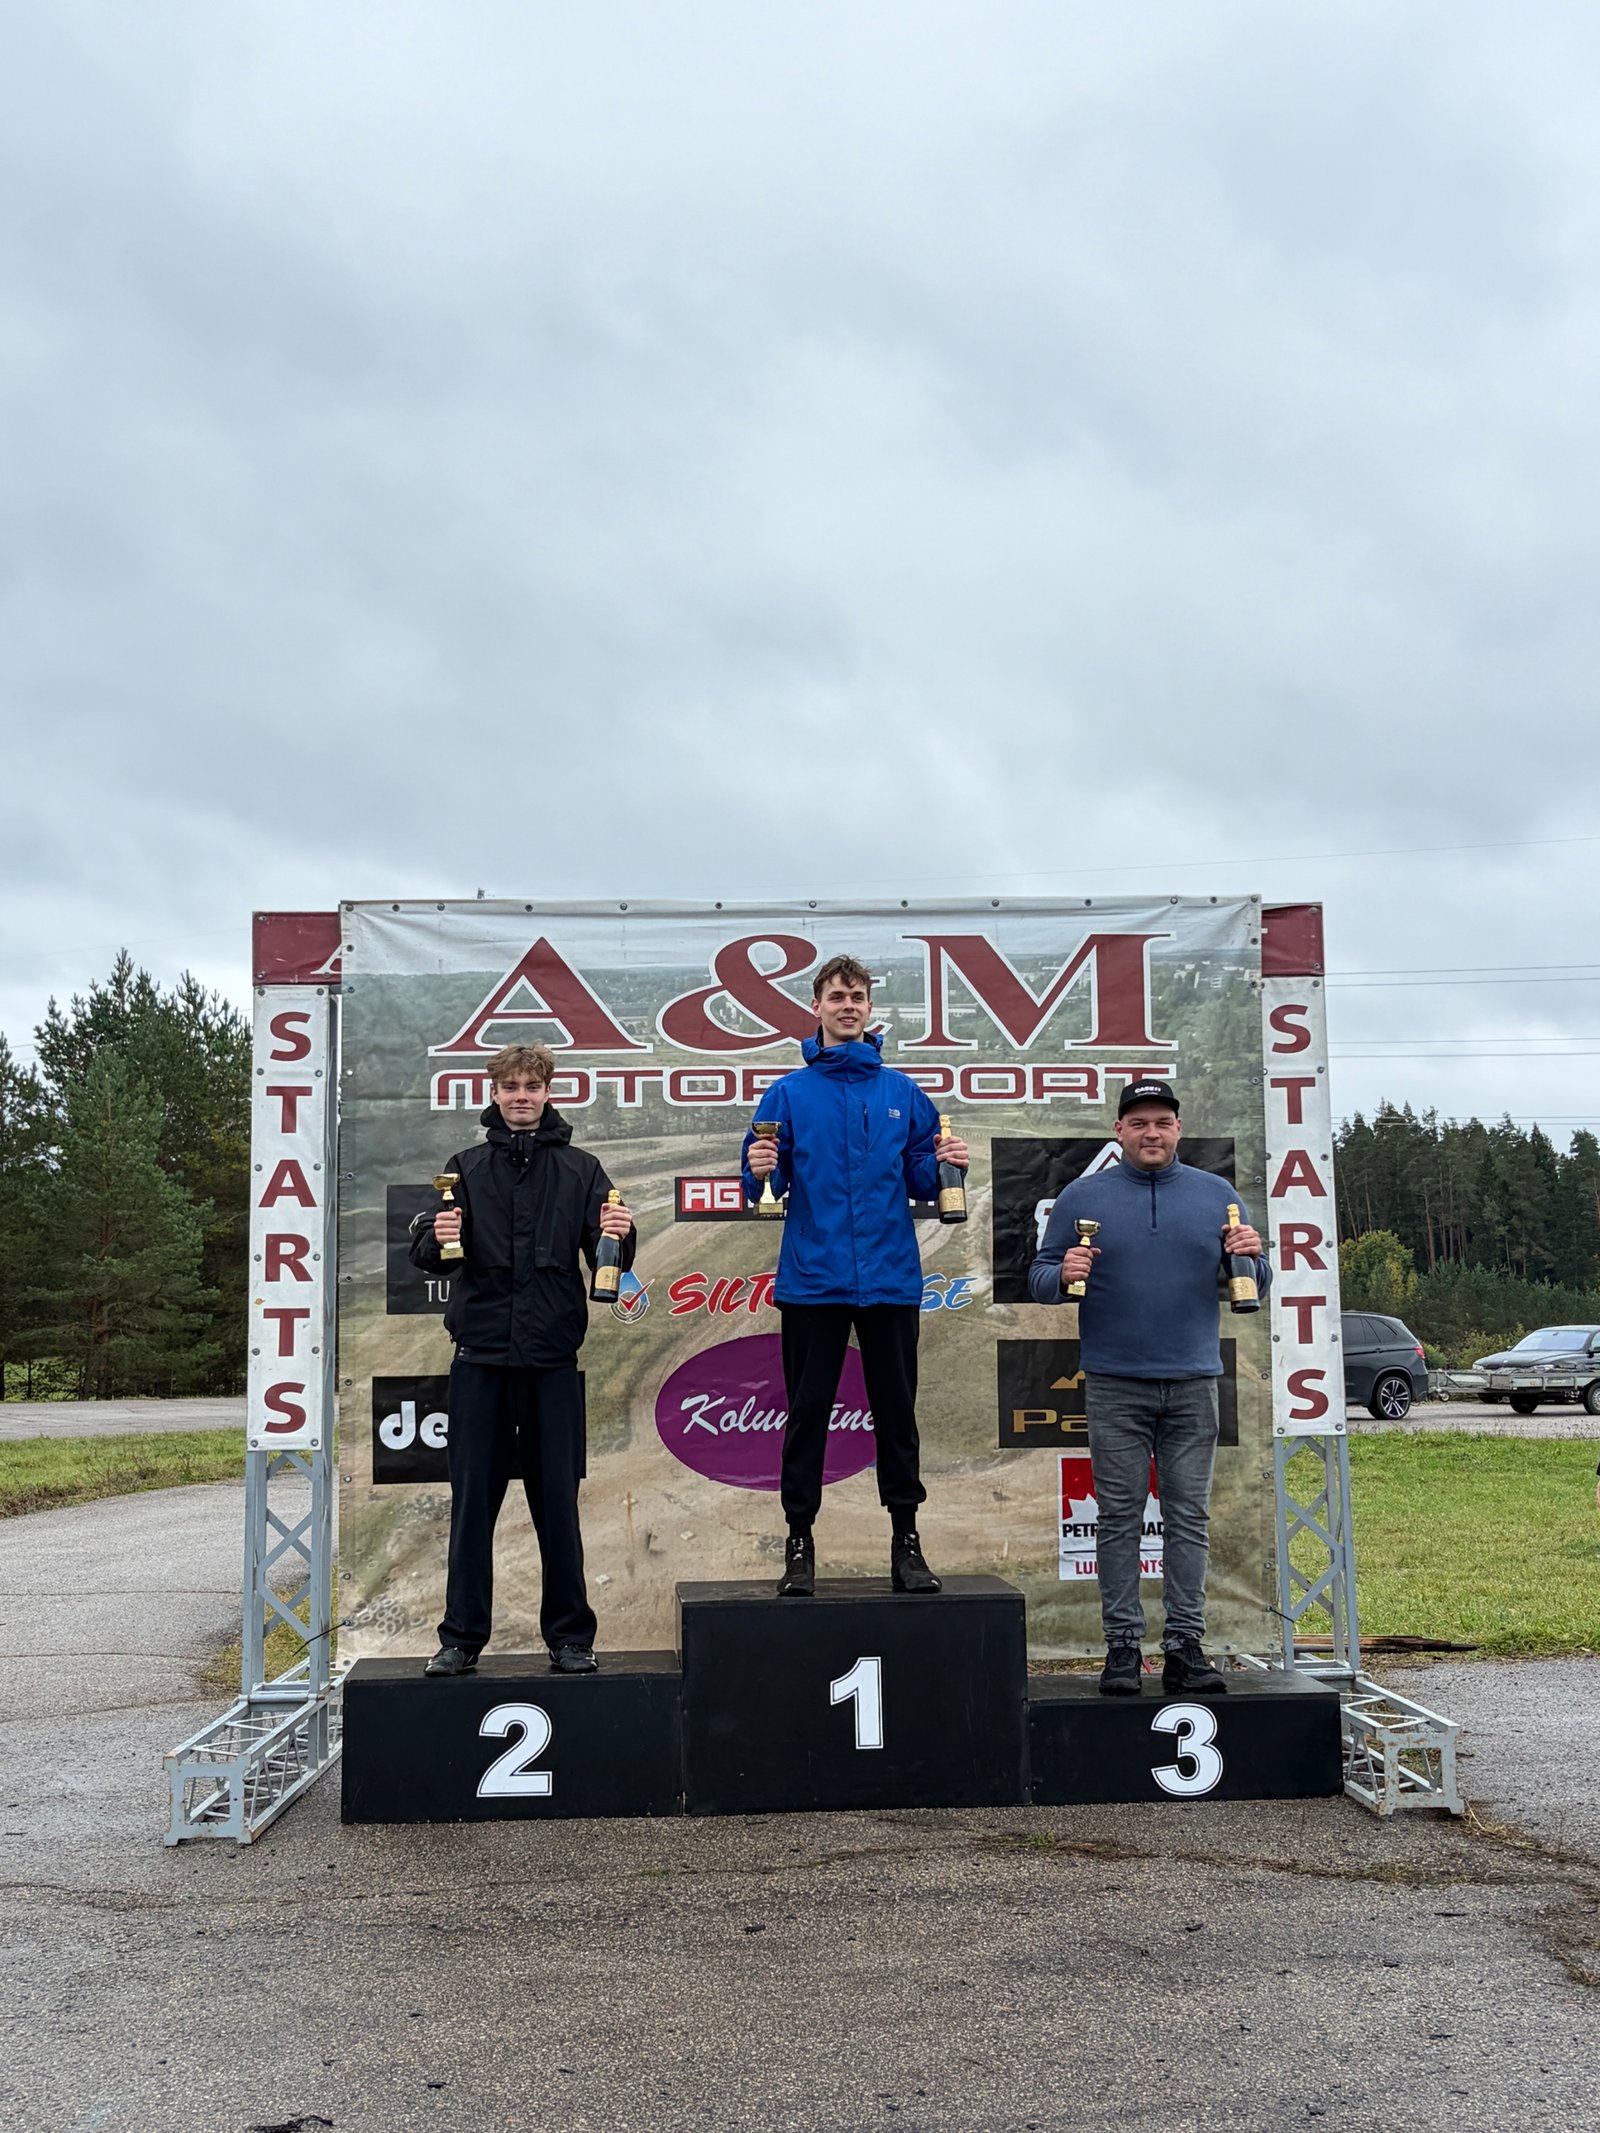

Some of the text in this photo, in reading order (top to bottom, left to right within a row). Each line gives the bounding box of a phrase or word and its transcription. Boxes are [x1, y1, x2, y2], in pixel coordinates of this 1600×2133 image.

[430, 1063, 1177, 1111] MOTORPORT
[257, 1011, 318, 1435] STARTS
[1268, 1003, 1330, 1421] STARTS
[476, 1702, 553, 1797] 2
[830, 1656, 884, 1750] 1
[1151, 1702, 1224, 1796] 3
